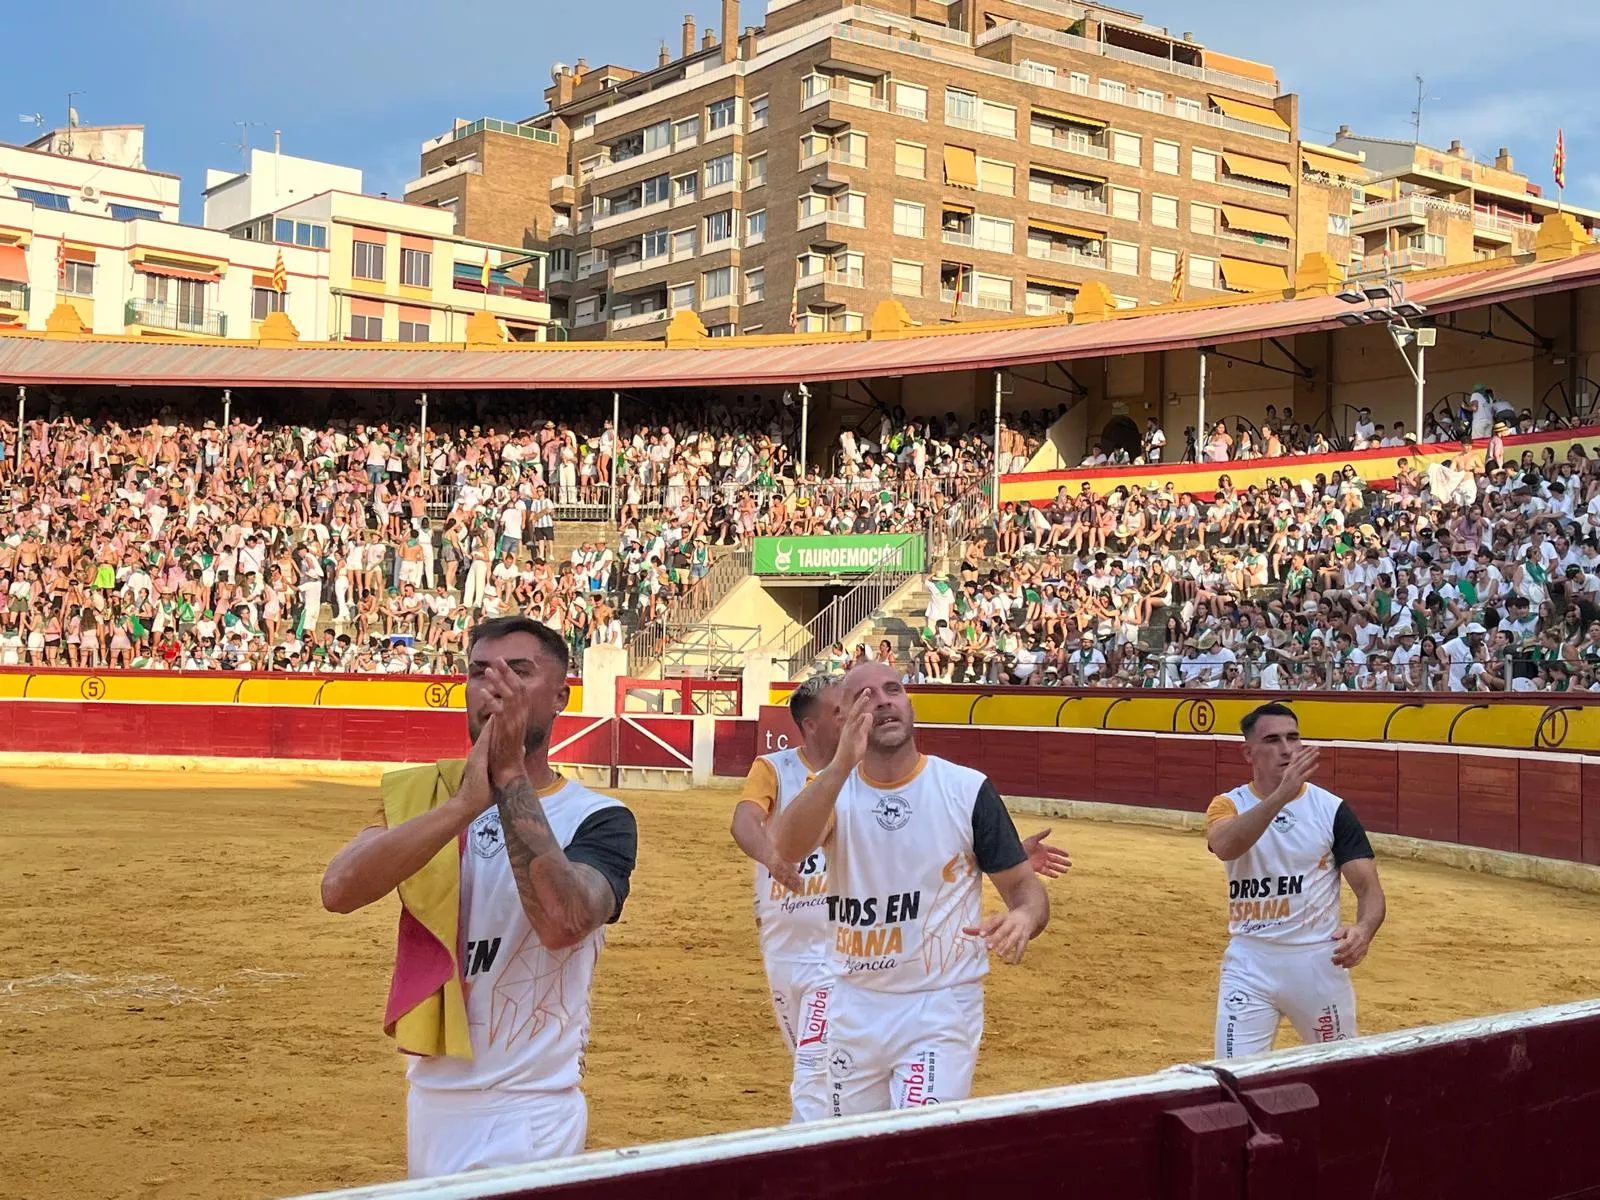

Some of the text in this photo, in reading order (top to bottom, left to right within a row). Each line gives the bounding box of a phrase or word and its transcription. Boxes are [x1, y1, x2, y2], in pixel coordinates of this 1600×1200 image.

[1229, 875, 1304, 899] OROS EN
[885, 890, 920, 924] EN
[1229, 896, 1290, 922] ESPAÑA
[799, 991, 828, 1048] Lomba
[832, 1093, 842, 1117] cast
